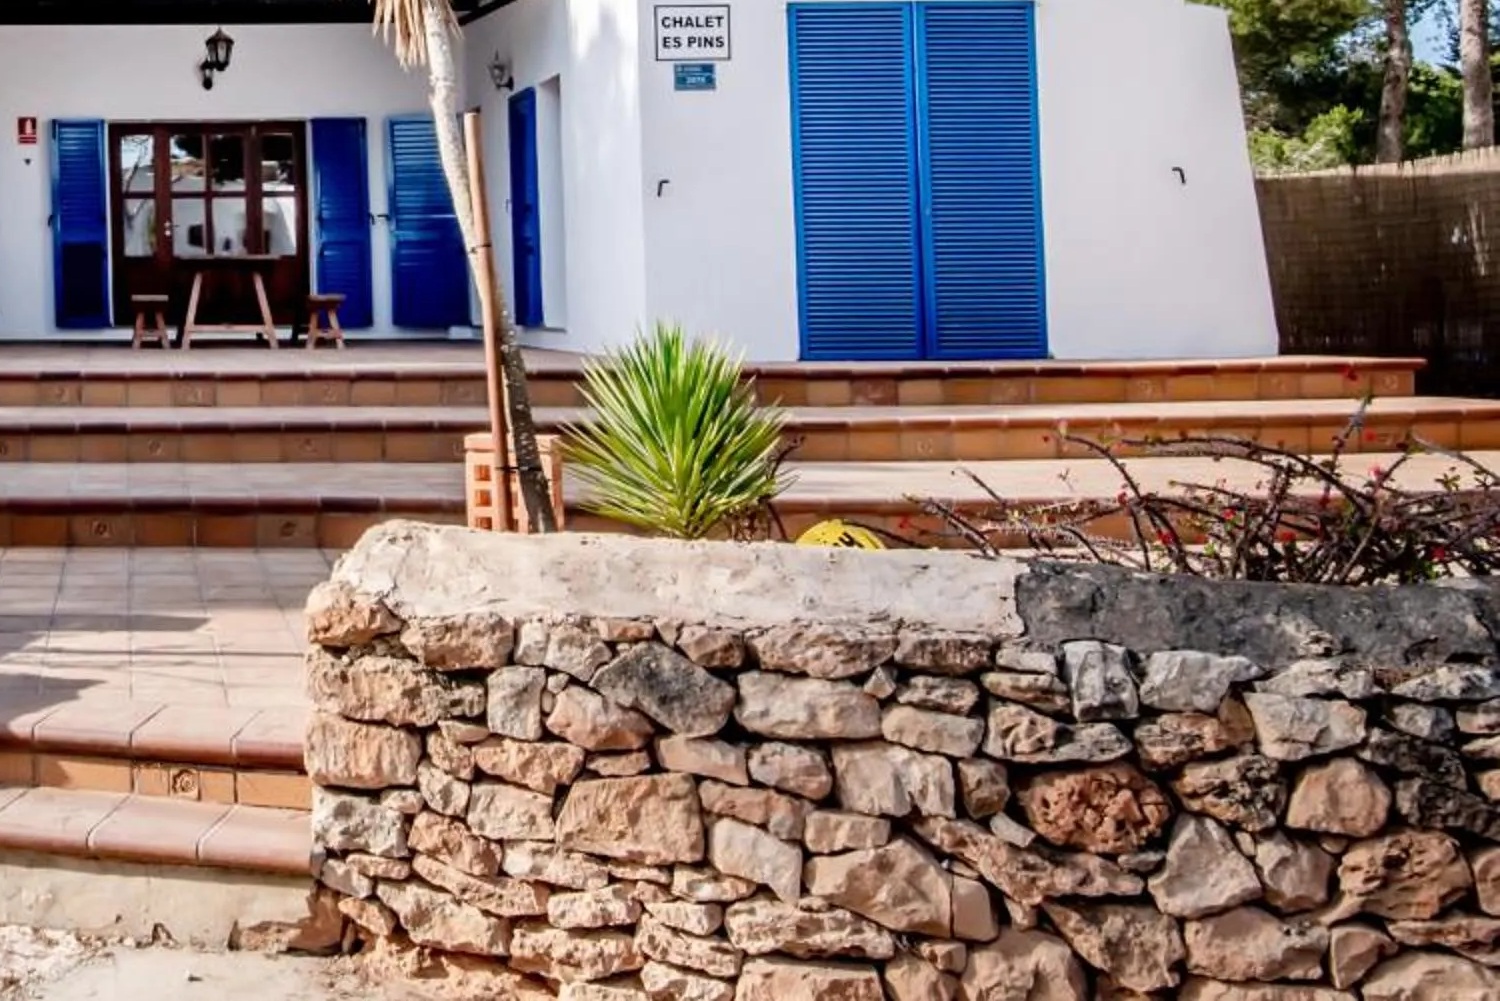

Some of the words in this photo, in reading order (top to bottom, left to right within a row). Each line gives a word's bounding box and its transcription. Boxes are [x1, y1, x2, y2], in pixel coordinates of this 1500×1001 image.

[661, 15, 725, 28] CHALET
[662, 36, 682, 48] ES
[687, 36, 725, 48] PINS
